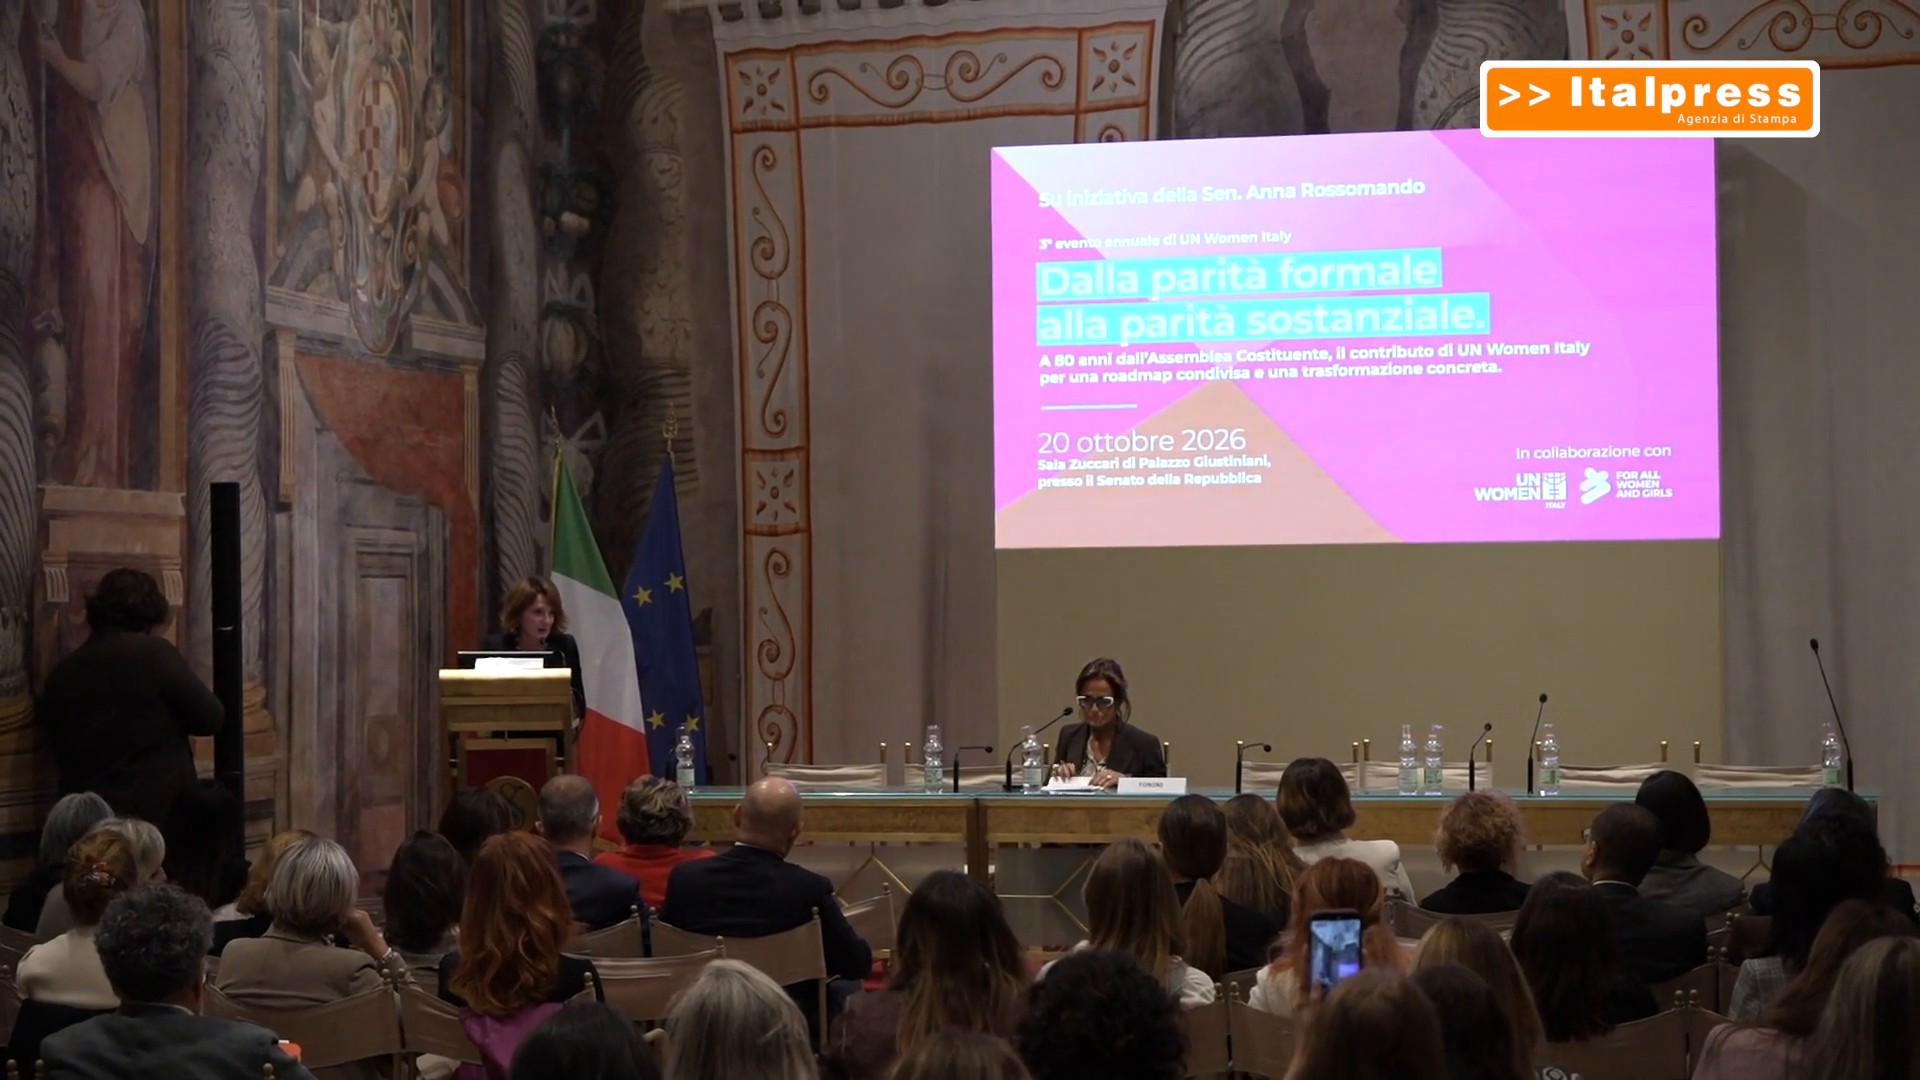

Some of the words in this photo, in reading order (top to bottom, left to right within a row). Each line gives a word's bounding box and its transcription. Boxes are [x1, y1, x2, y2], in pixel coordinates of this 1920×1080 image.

[1038, 192, 1062, 207] Su
[1066, 188, 1149, 207] iniziativa
[1153, 186, 1197, 203] della
[1202, 185, 1242, 201] Sen.
[1246, 184, 1296, 200] Anna
[1301, 178, 1426, 198] Rossomando
[1055, 236, 1100, 249] evento
[1104, 234, 1159, 247] annuale
[1163, 233, 1176, 245] di
[1180, 233, 1200, 245] UN
[1204, 232, 1258, 244] Women
[1262, 229, 1292, 244] Italy
[1041, 262, 1139, 296] Dalla
[1152, 256, 1267, 301] parità
[1278, 253, 1437, 290] formale
[1039, 308, 1107, 341] alla
[1120, 303, 1235, 347] parità
[1246, 296, 1486, 335] sostanziale.
[1039, 354, 1051, 367] A
[1054, 354, 1075, 367] 80
[1078, 351, 1112, 366] anni
[1236, 347, 1333, 363] Costituente,
[1336, 346, 1346, 359] il
[1350, 344, 1434, 360] contributo
[1438, 343, 1453, 357] di
[1457, 343, 1482, 357] UN
[1486, 342, 1550, 356] Women
[1554, 340, 1591, 357] Italy
[1039, 372, 1066, 387] per
[1069, 371, 1098, 384] una
[1102, 368, 1173, 384] roadmap
[1176, 366, 1250, 381] condivisa
[1254, 367, 1264, 379] e
[1268, 366, 1298, 379] una
[1302, 362, 1423, 378] trasformazione
[1426, 361, 1502, 374] concreta.
[1037, 431, 1070, 454] 20
[1076, 429, 1175, 454] ottobre
[1181, 428, 1247, 451] 2026
[1516, 447, 1530, 459] In
[1533, 445, 1640, 459] collaborazione
[1643, 446, 1671, 458] con
[1037, 458, 1066, 471] Sala
[1068, 456, 1119, 470] Zuccari
[1122, 456, 1136, 469] di
[1139, 455, 1190, 468] Palazzo
[1193, 454, 1271, 468] Giustiniani,
[1038, 476, 1083, 490] presso
[1086, 474, 1093, 486] il
[1097, 473, 1145, 486] Senato
[1148, 472, 1181, 485] della
[1184, 471, 1262, 487] Repubblica
[1516, 472, 1540, 486] UN
[1616, 471, 1638, 480] FOR
[1640, 470, 1660, 480] ALL
[1616, 480, 1660, 489] WOMEN
[1474, 487, 1541, 501] WOMEN
[1616, 489, 1640, 498] AND
[1642, 488, 1673, 498] GIRLS
